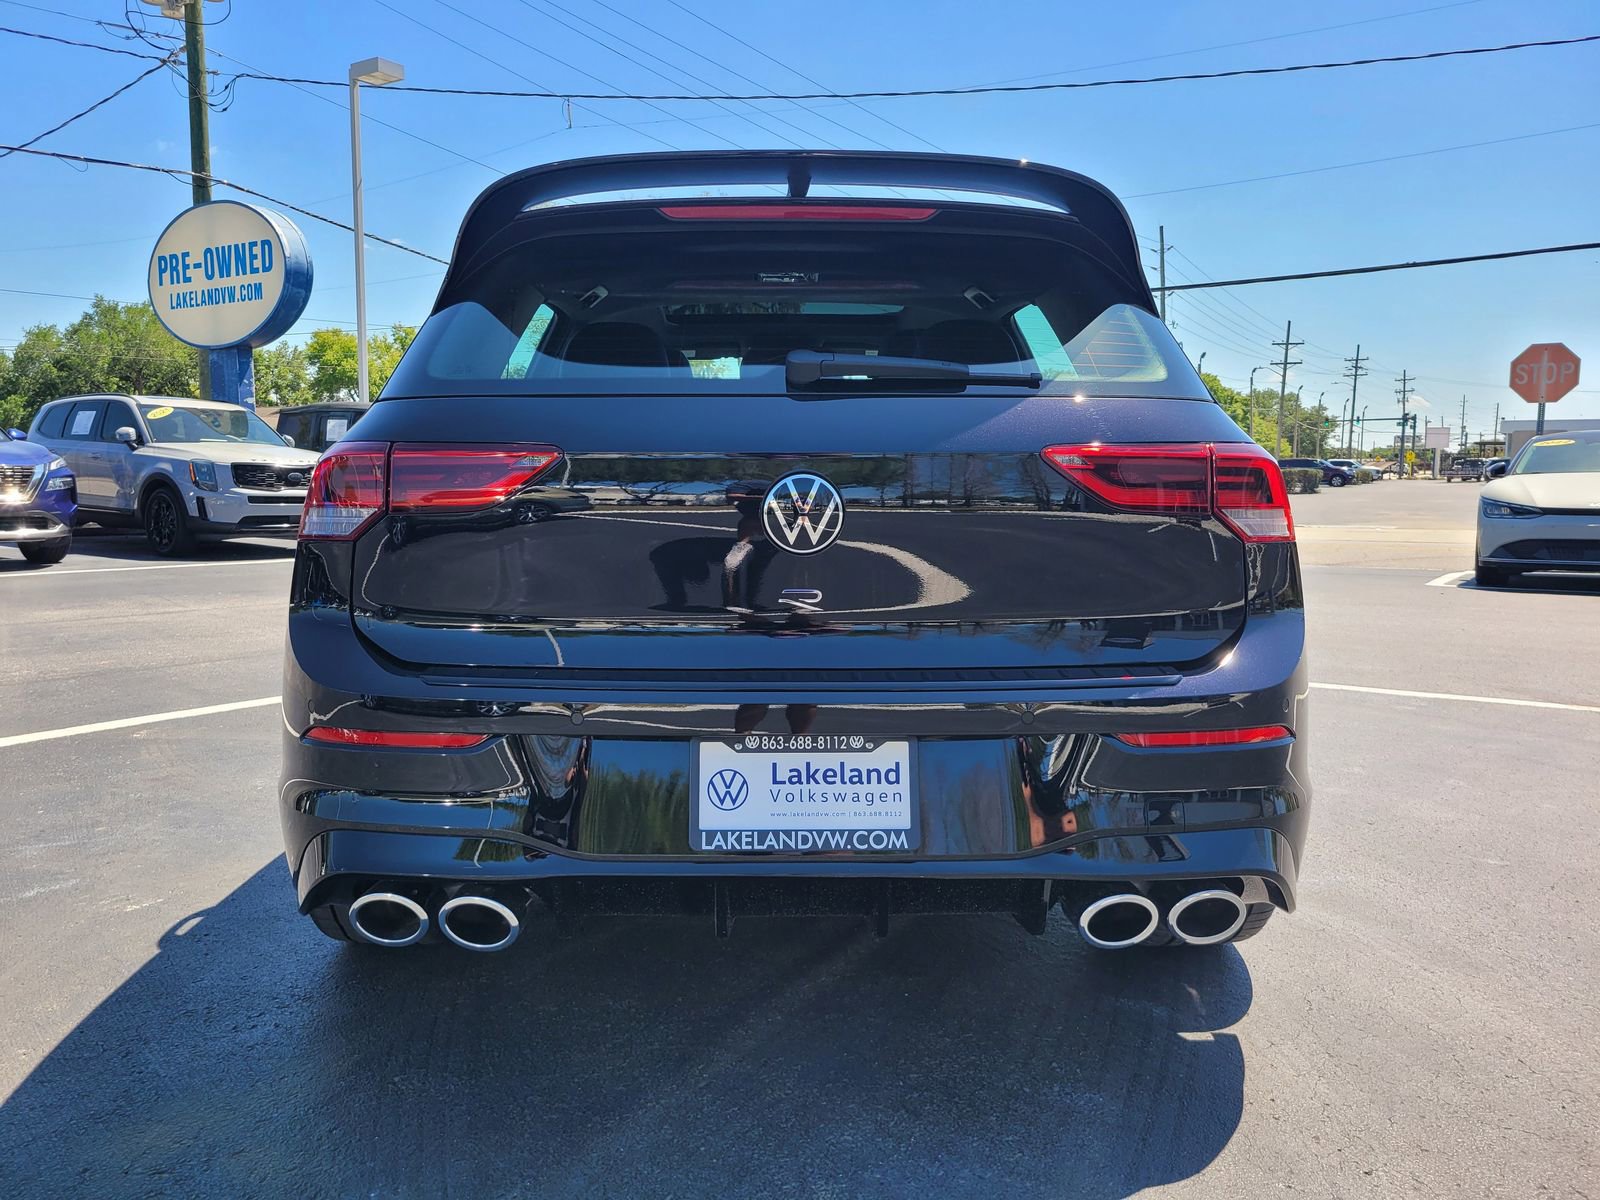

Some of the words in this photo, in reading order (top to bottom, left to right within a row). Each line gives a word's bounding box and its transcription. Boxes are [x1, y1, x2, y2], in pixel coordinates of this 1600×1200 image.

[157, 239, 274, 287] PRE-OWNED
[170, 282, 263, 310] LAKELANDVW.COM
[1515, 362, 1575, 385] STOP
[761, 735, 847, 750] 863-688-8112
[771, 761, 900, 785] Lakeland
[769, 789, 902, 806] Volkswagen
[701, 830, 909, 850] LAKELANDVW.COM
